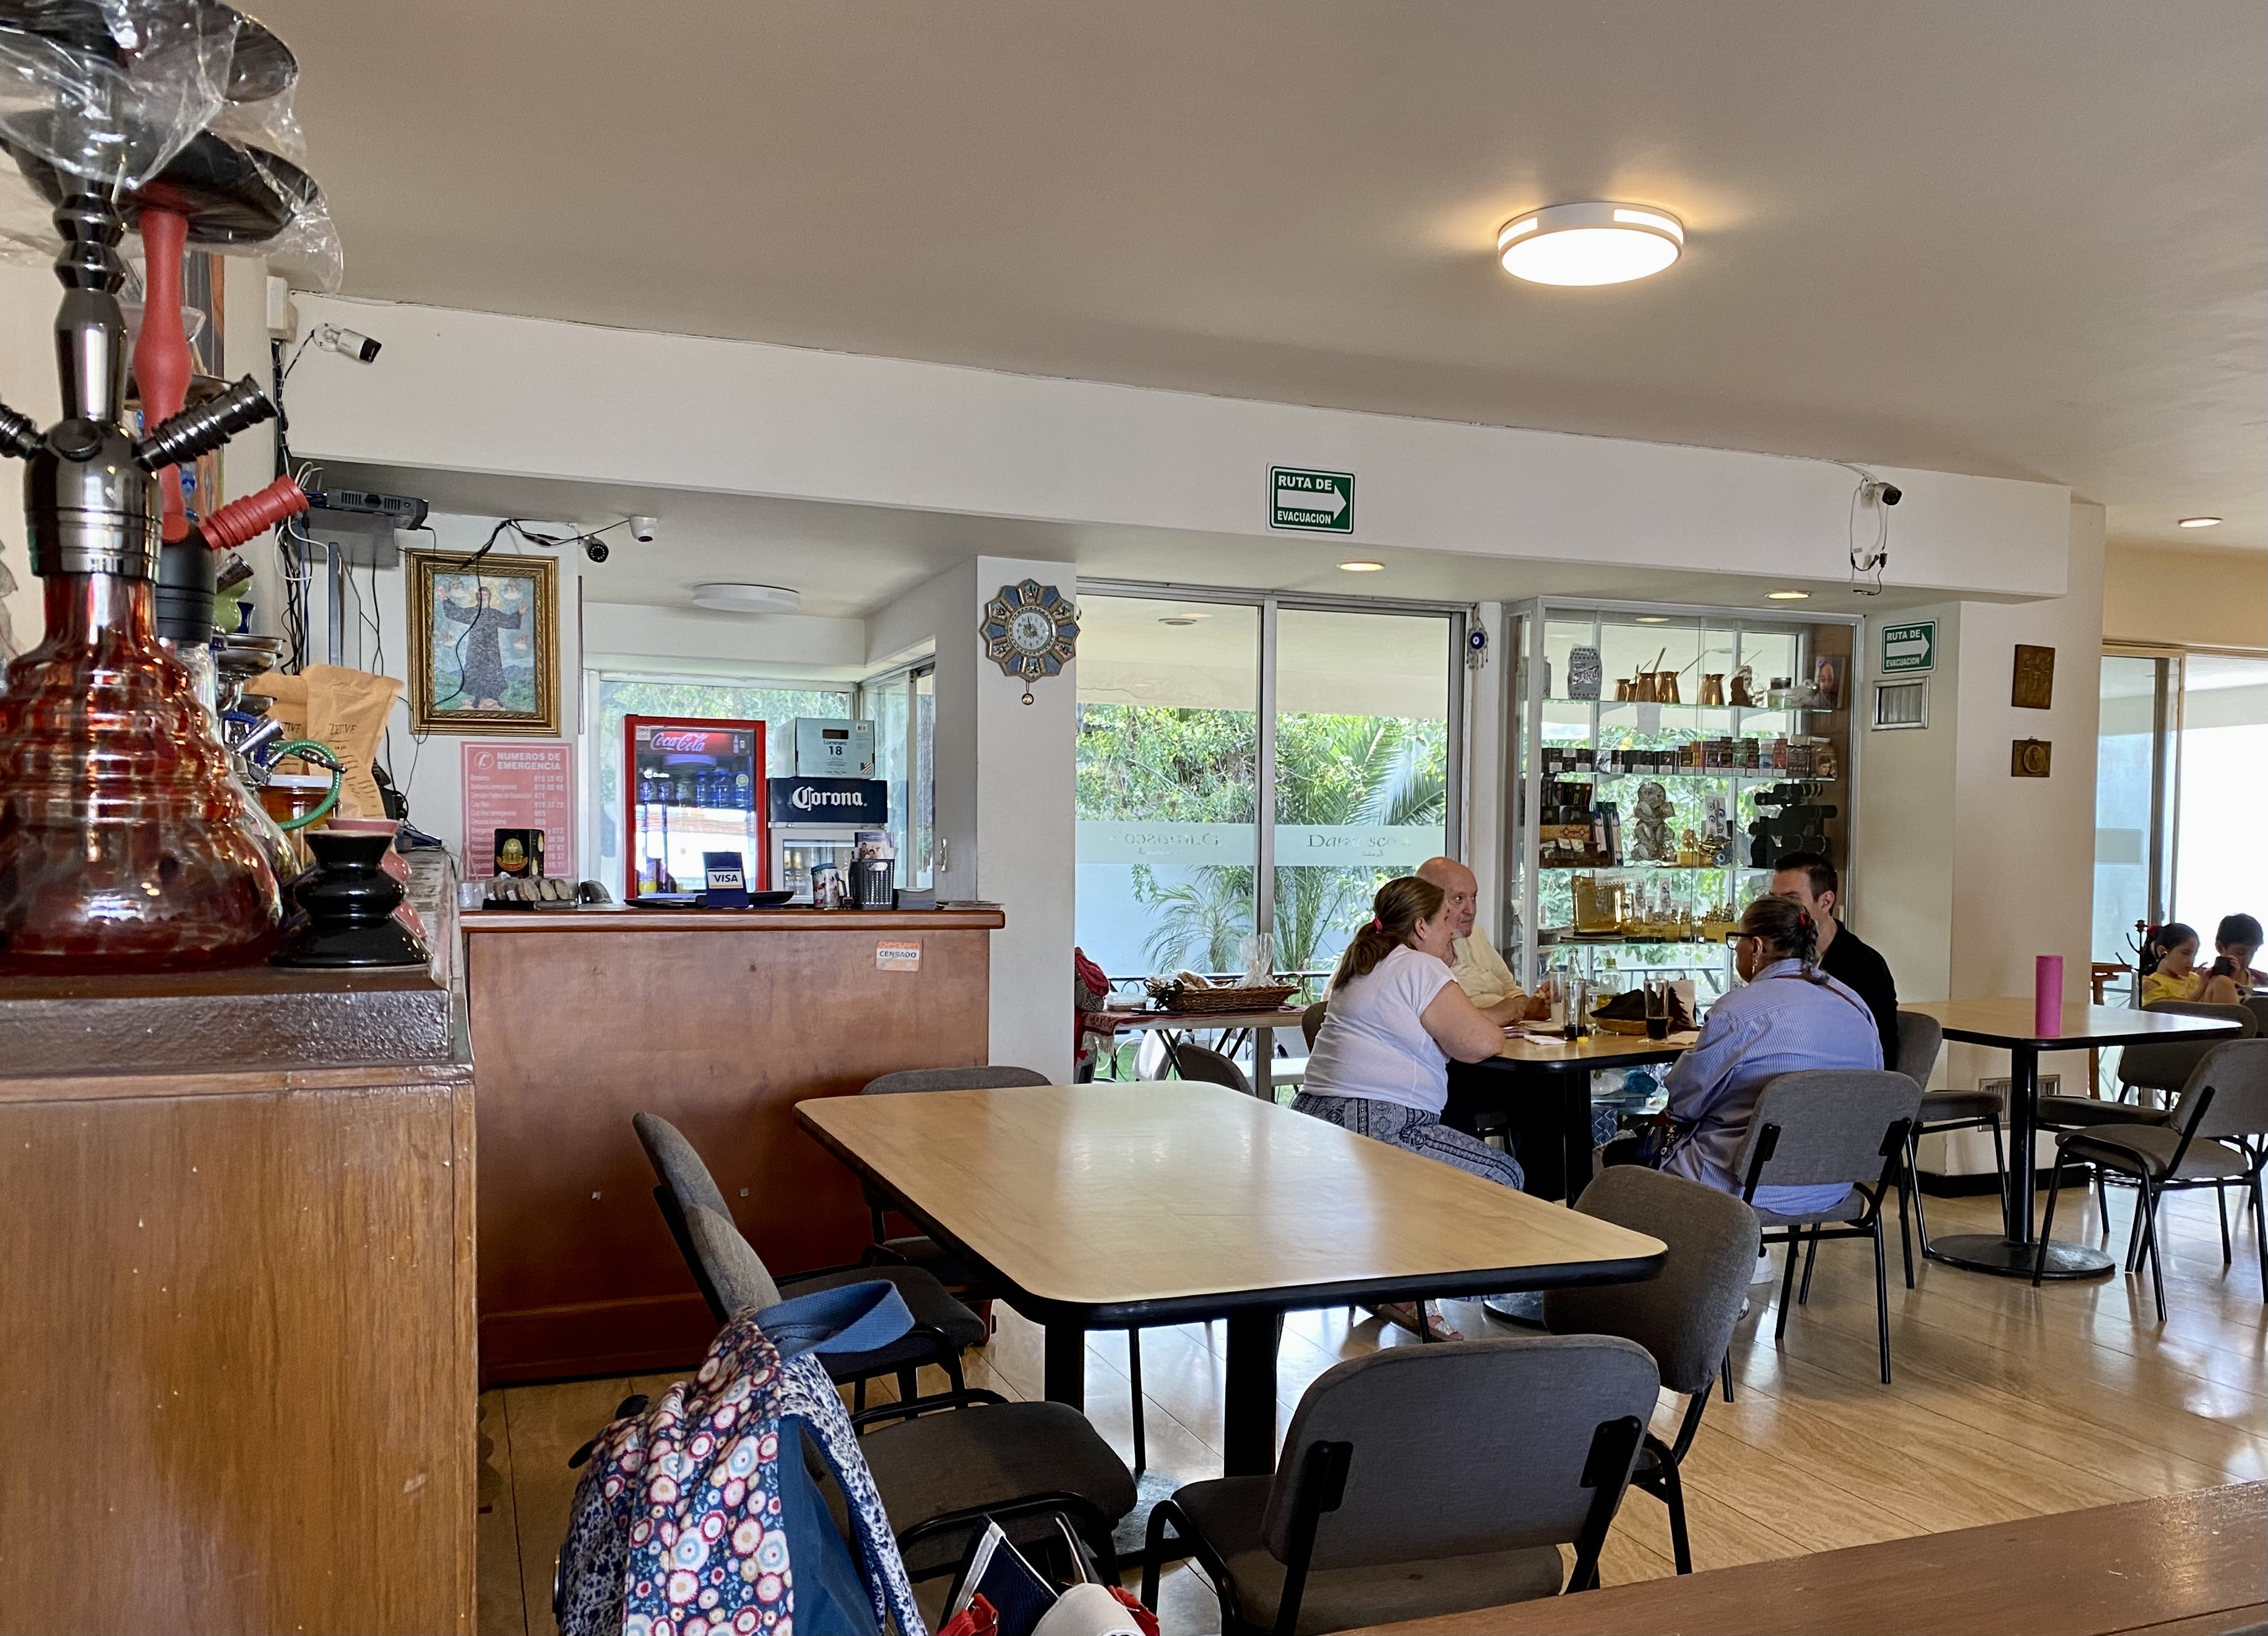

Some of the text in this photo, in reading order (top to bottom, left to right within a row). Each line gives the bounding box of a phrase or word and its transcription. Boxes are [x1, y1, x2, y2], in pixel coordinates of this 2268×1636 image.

[1278, 475, 1332, 490] RUTA DE
[1277, 510, 1331, 524] EVACUACION
[1887, 629, 1921, 641] RUTA DE
[1886, 657, 1920, 667] EVACUACION
[829, 746, 843, 756] 18
[497, 752, 561, 761] NUMEROS DE
[497, 762, 561, 770] EMERGENCIA
[792, 786, 863, 812] Corona
[712, 874, 738, 882] VISA
[879, 950, 916, 958] CENSADO
